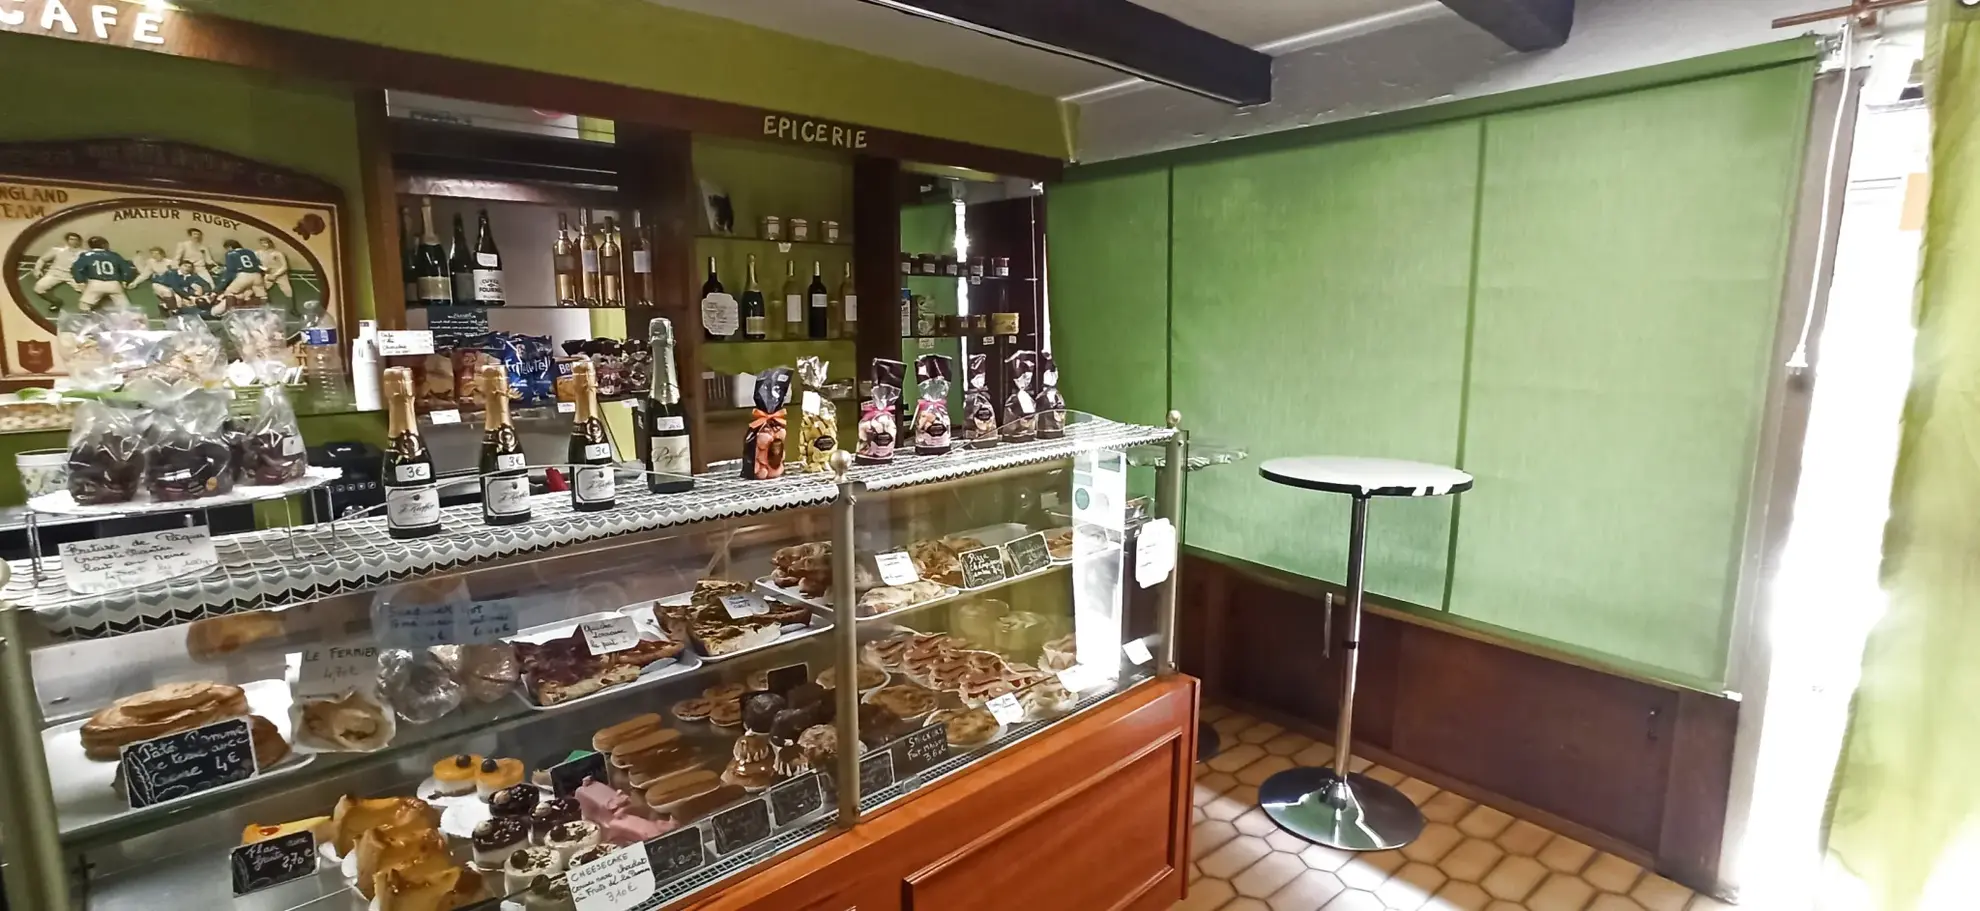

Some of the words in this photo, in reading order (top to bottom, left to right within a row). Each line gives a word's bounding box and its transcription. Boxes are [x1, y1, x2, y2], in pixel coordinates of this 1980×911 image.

[763, 115, 868, 149] EPICERIE
[112, 206, 181, 222] AMATEUR
[192, 211, 242, 232] RUGBY
[92, 259, 115, 276] 10
[594, 445, 609, 456] 3€
[508, 456, 524, 467] 3€
[406, 466, 427, 478] 3€
[303, 650, 321, 662] LE
[570, 852, 629, 882] CHEESECAKE
